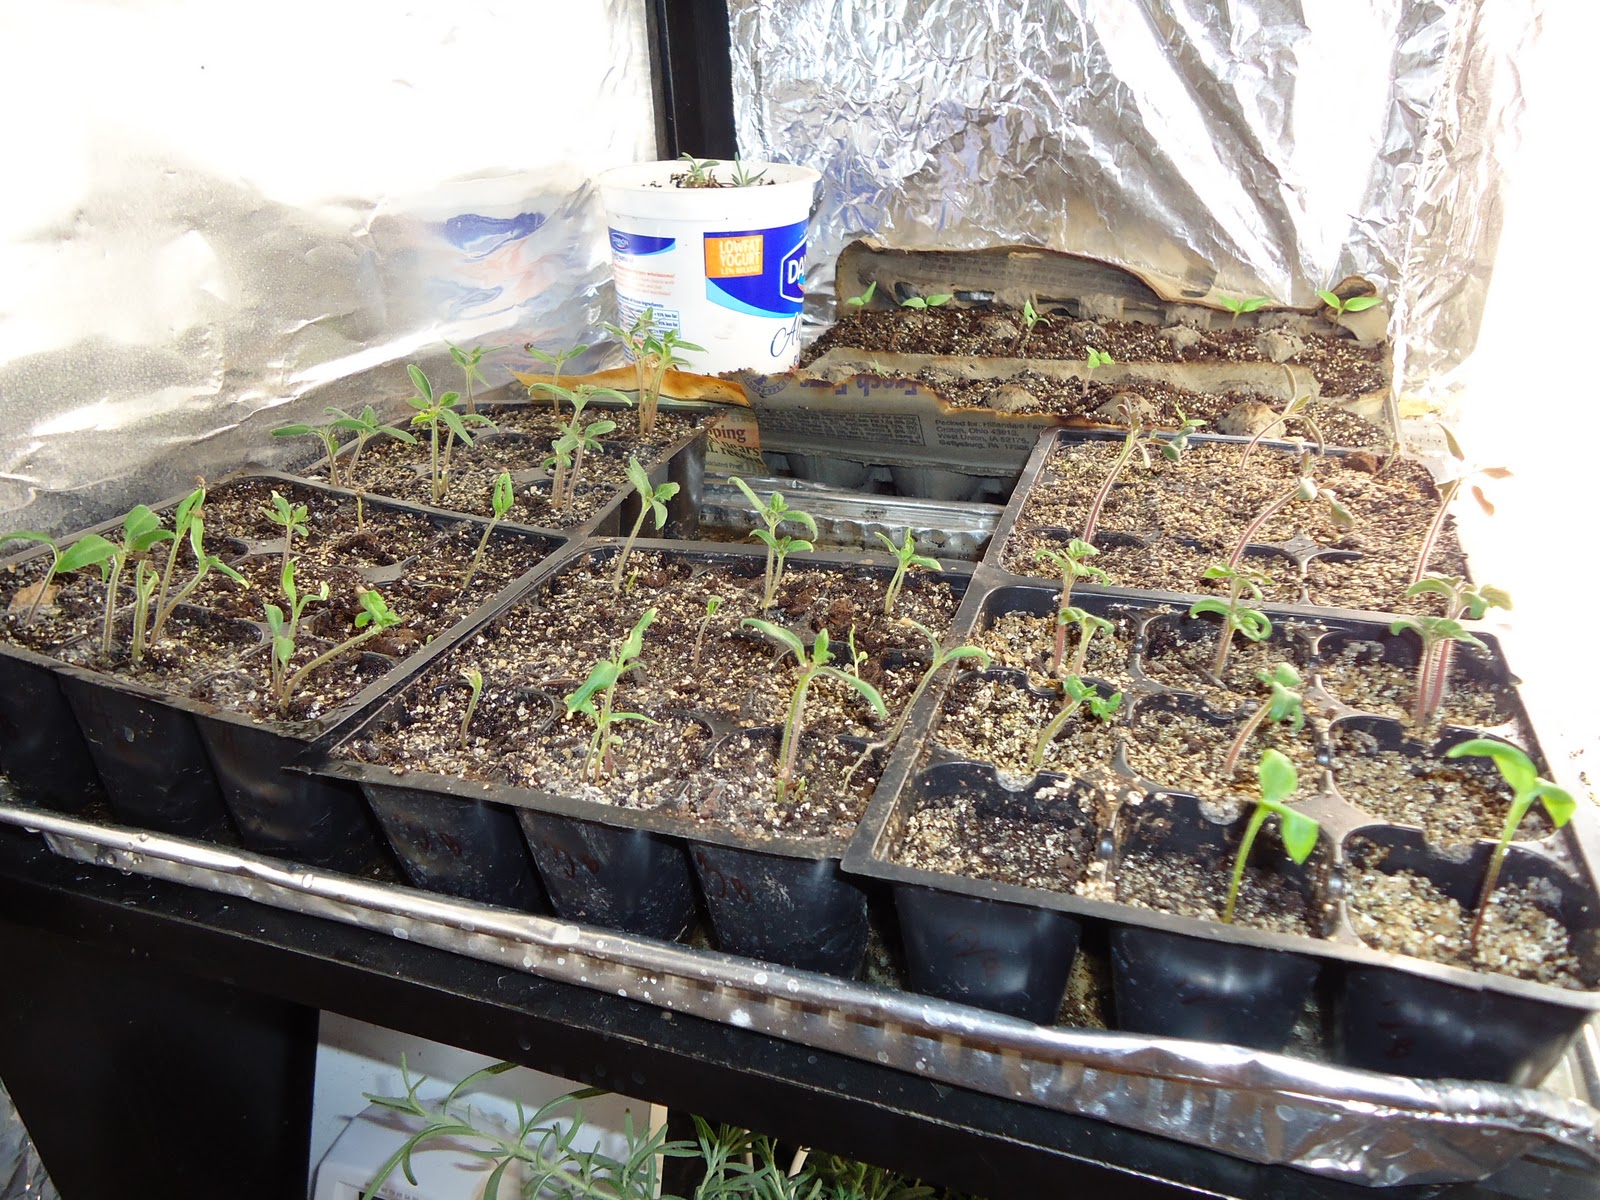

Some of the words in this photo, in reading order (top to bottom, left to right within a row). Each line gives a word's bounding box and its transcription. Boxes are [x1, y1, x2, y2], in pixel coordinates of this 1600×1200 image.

[719, 239, 761, 253] LOWFAT
[719, 252, 761, 266] YOGURT
[935, 419, 966, 427] Packed
